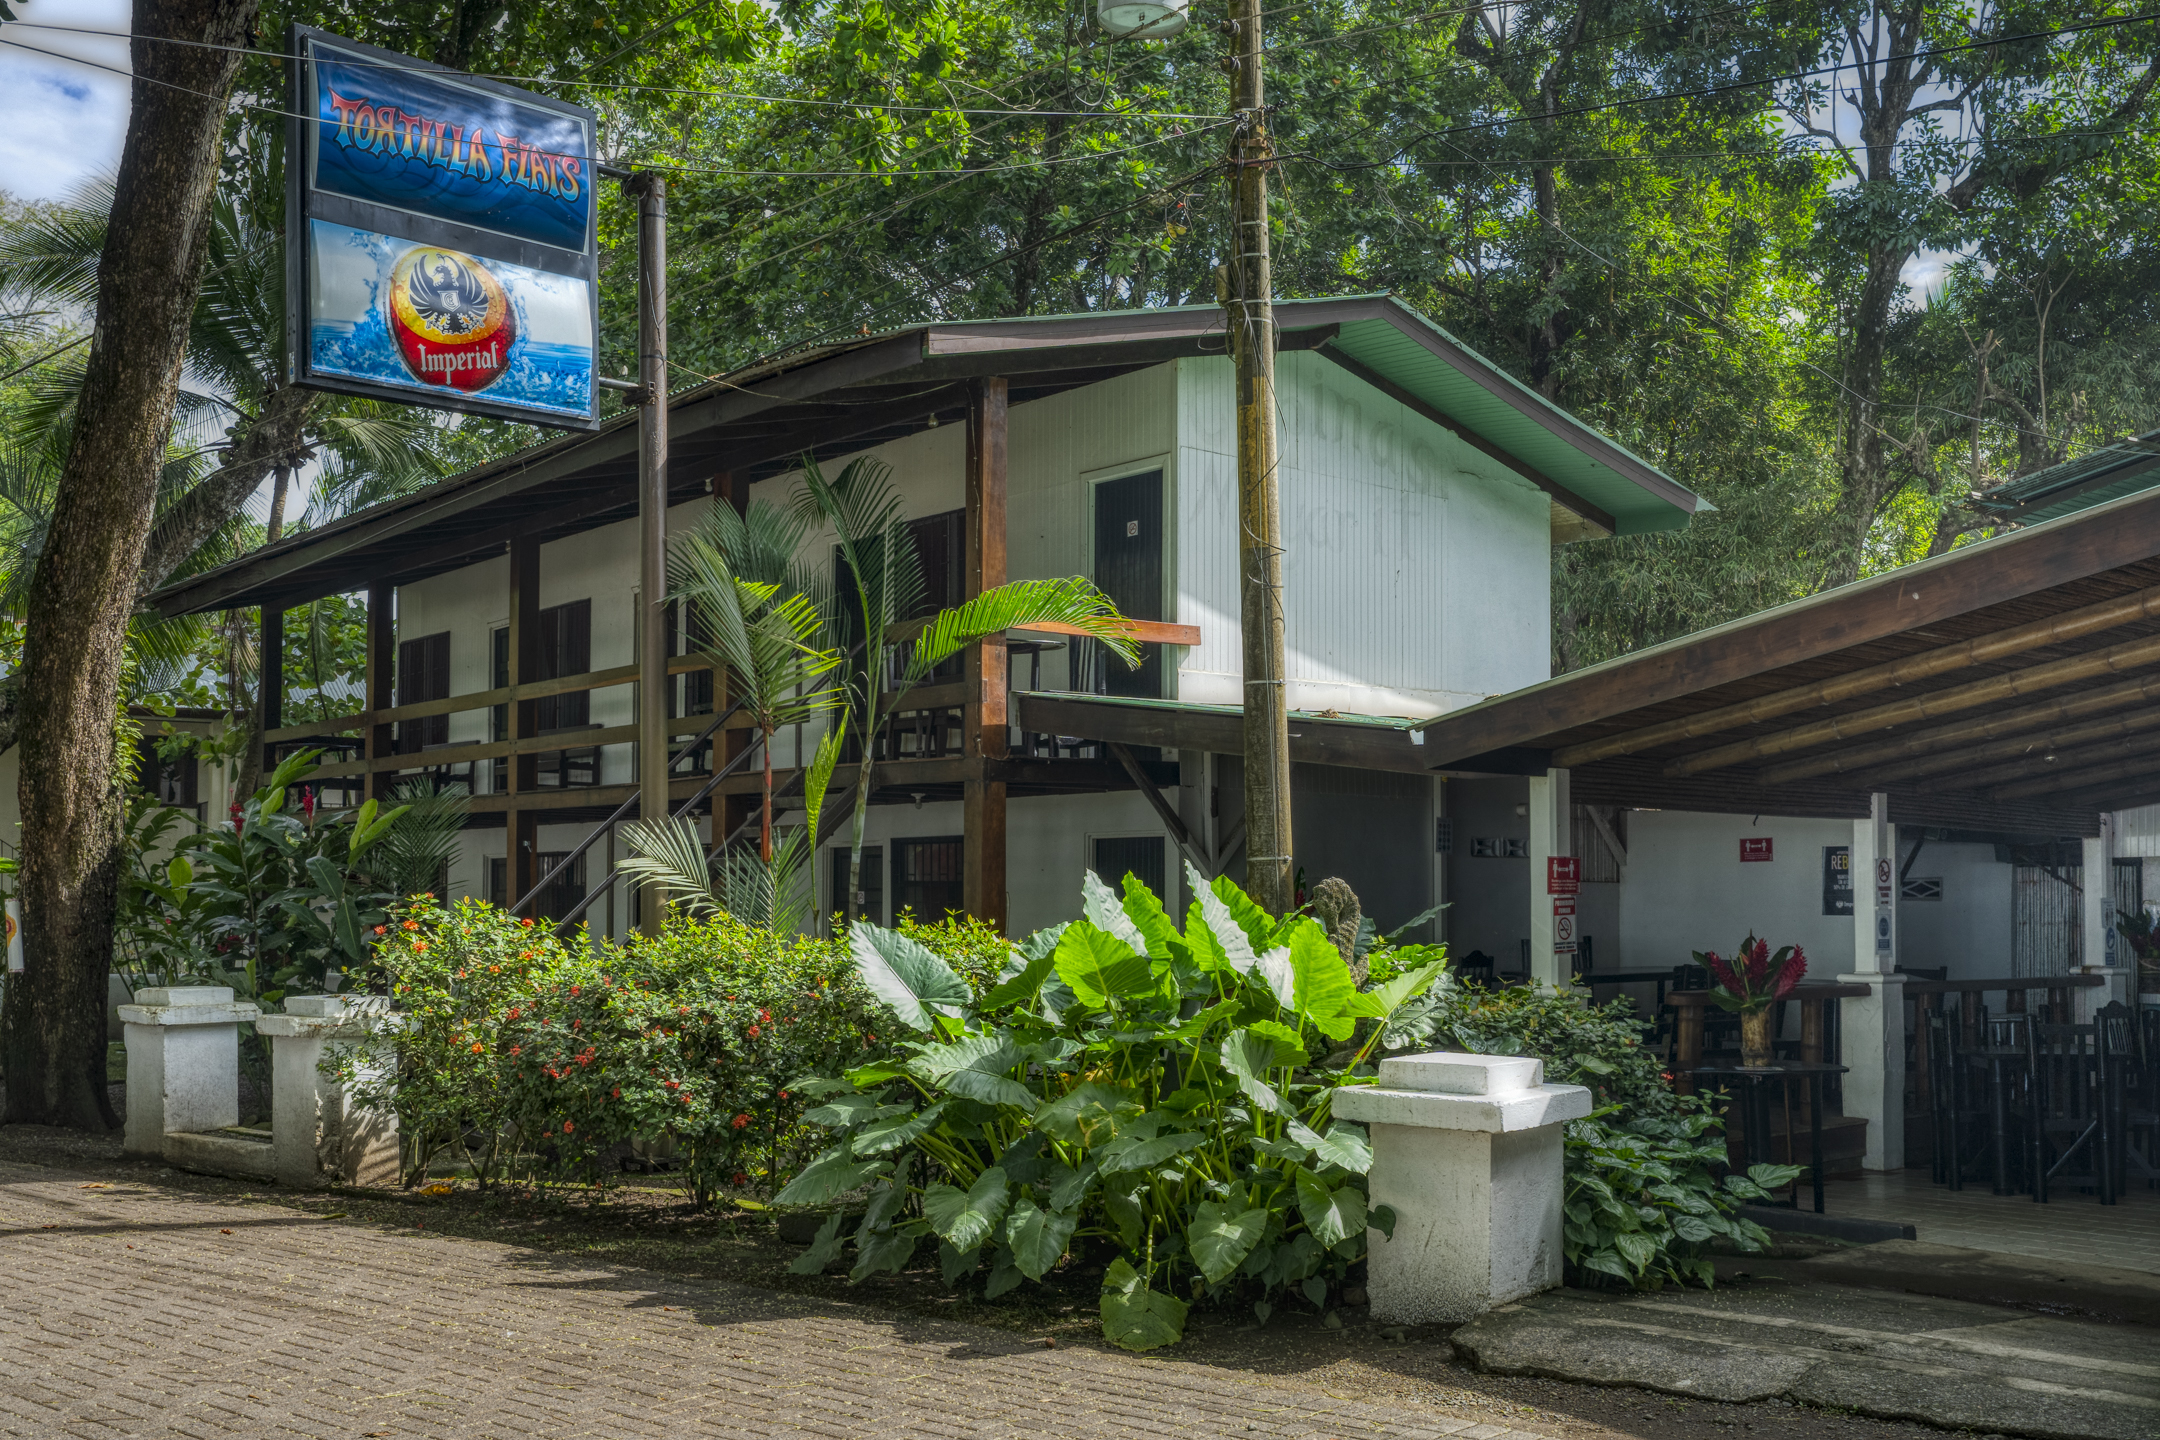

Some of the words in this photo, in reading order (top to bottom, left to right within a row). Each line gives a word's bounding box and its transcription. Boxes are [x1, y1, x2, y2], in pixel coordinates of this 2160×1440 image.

[328, 87, 492, 182] TORTILLA
[495, 130, 581, 203] FLATS
[417, 341, 499, 386] Imperial
[1188, 455, 1423, 571] Nyarit
